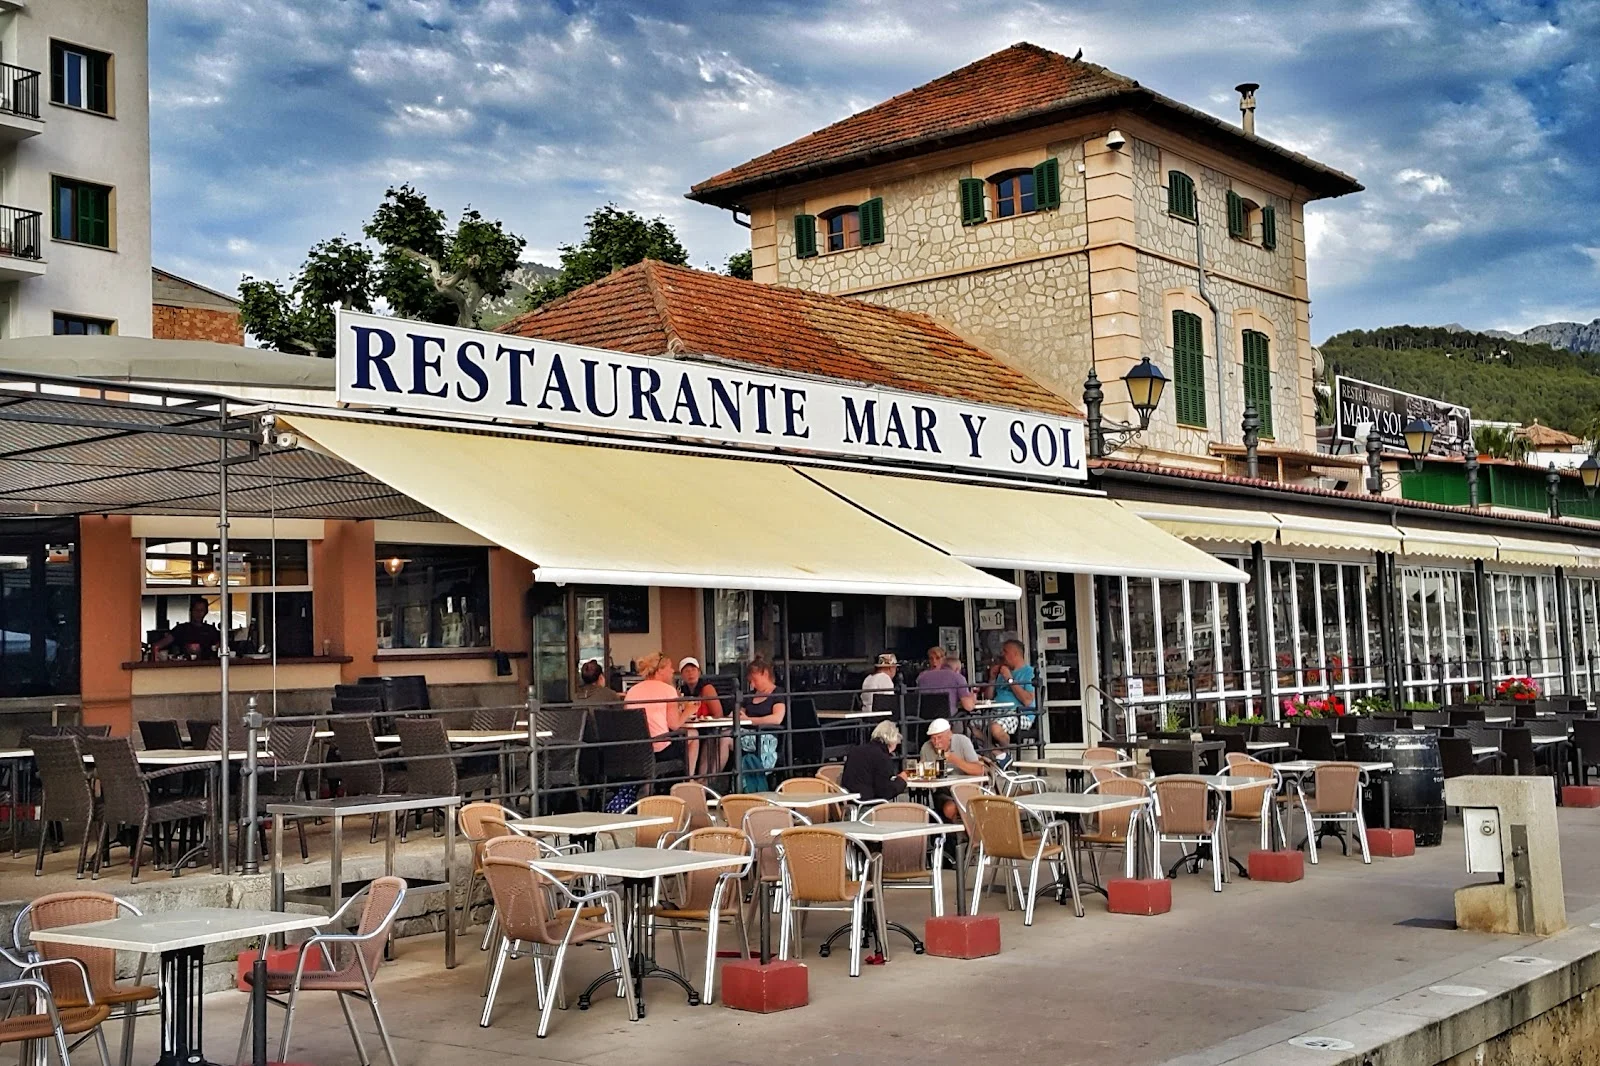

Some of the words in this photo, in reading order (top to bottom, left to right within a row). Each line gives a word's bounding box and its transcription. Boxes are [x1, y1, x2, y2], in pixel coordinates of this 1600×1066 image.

[350, 325, 810, 439] RESTAURANTE
[841, 395, 942, 454] MAR
[959, 412, 987, 459] Y
[1009, 419, 1081, 471] SOL
[1342, 384, 1390, 407] RESTAURANTE
[1343, 401, 1370, 427] MAR
[1373, 408, 1380, 431] Y
[1383, 411, 1404, 437] SOL
